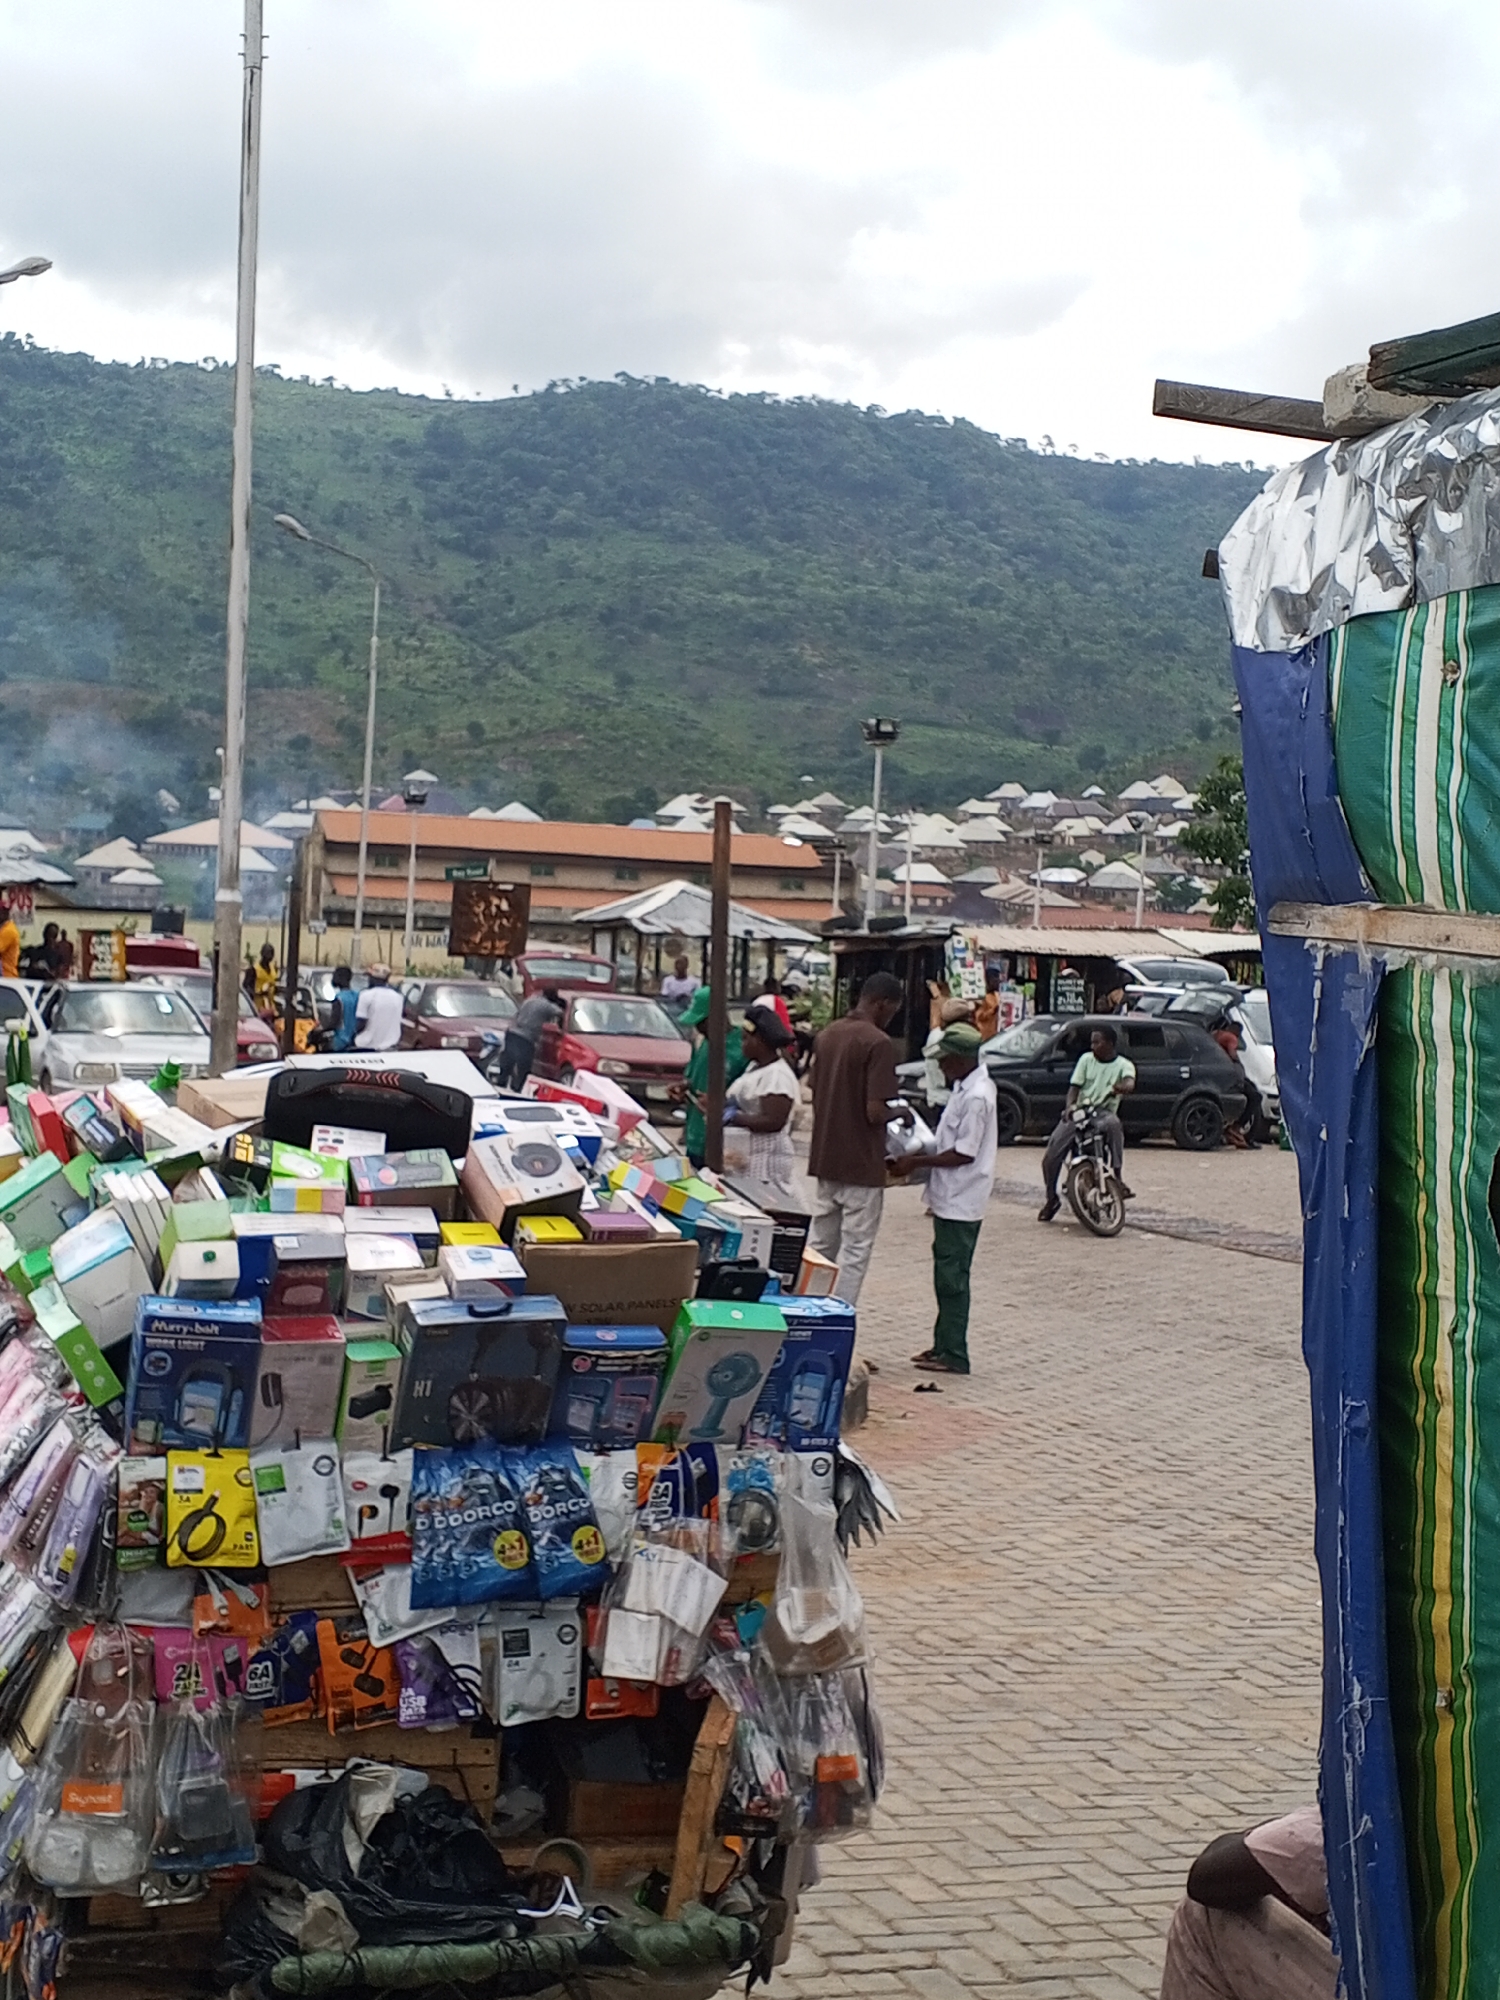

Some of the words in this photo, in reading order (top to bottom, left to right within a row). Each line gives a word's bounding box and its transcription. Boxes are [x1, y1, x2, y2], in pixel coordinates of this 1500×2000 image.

[580, 1301, 625, 1313] SOLAR
[628, 1298, 677, 1310] PANELS
[449, 1501, 515, 1526] DORCO
[529, 1499, 590, 1522] DORCO
[399, 1696, 427, 1708] USB
